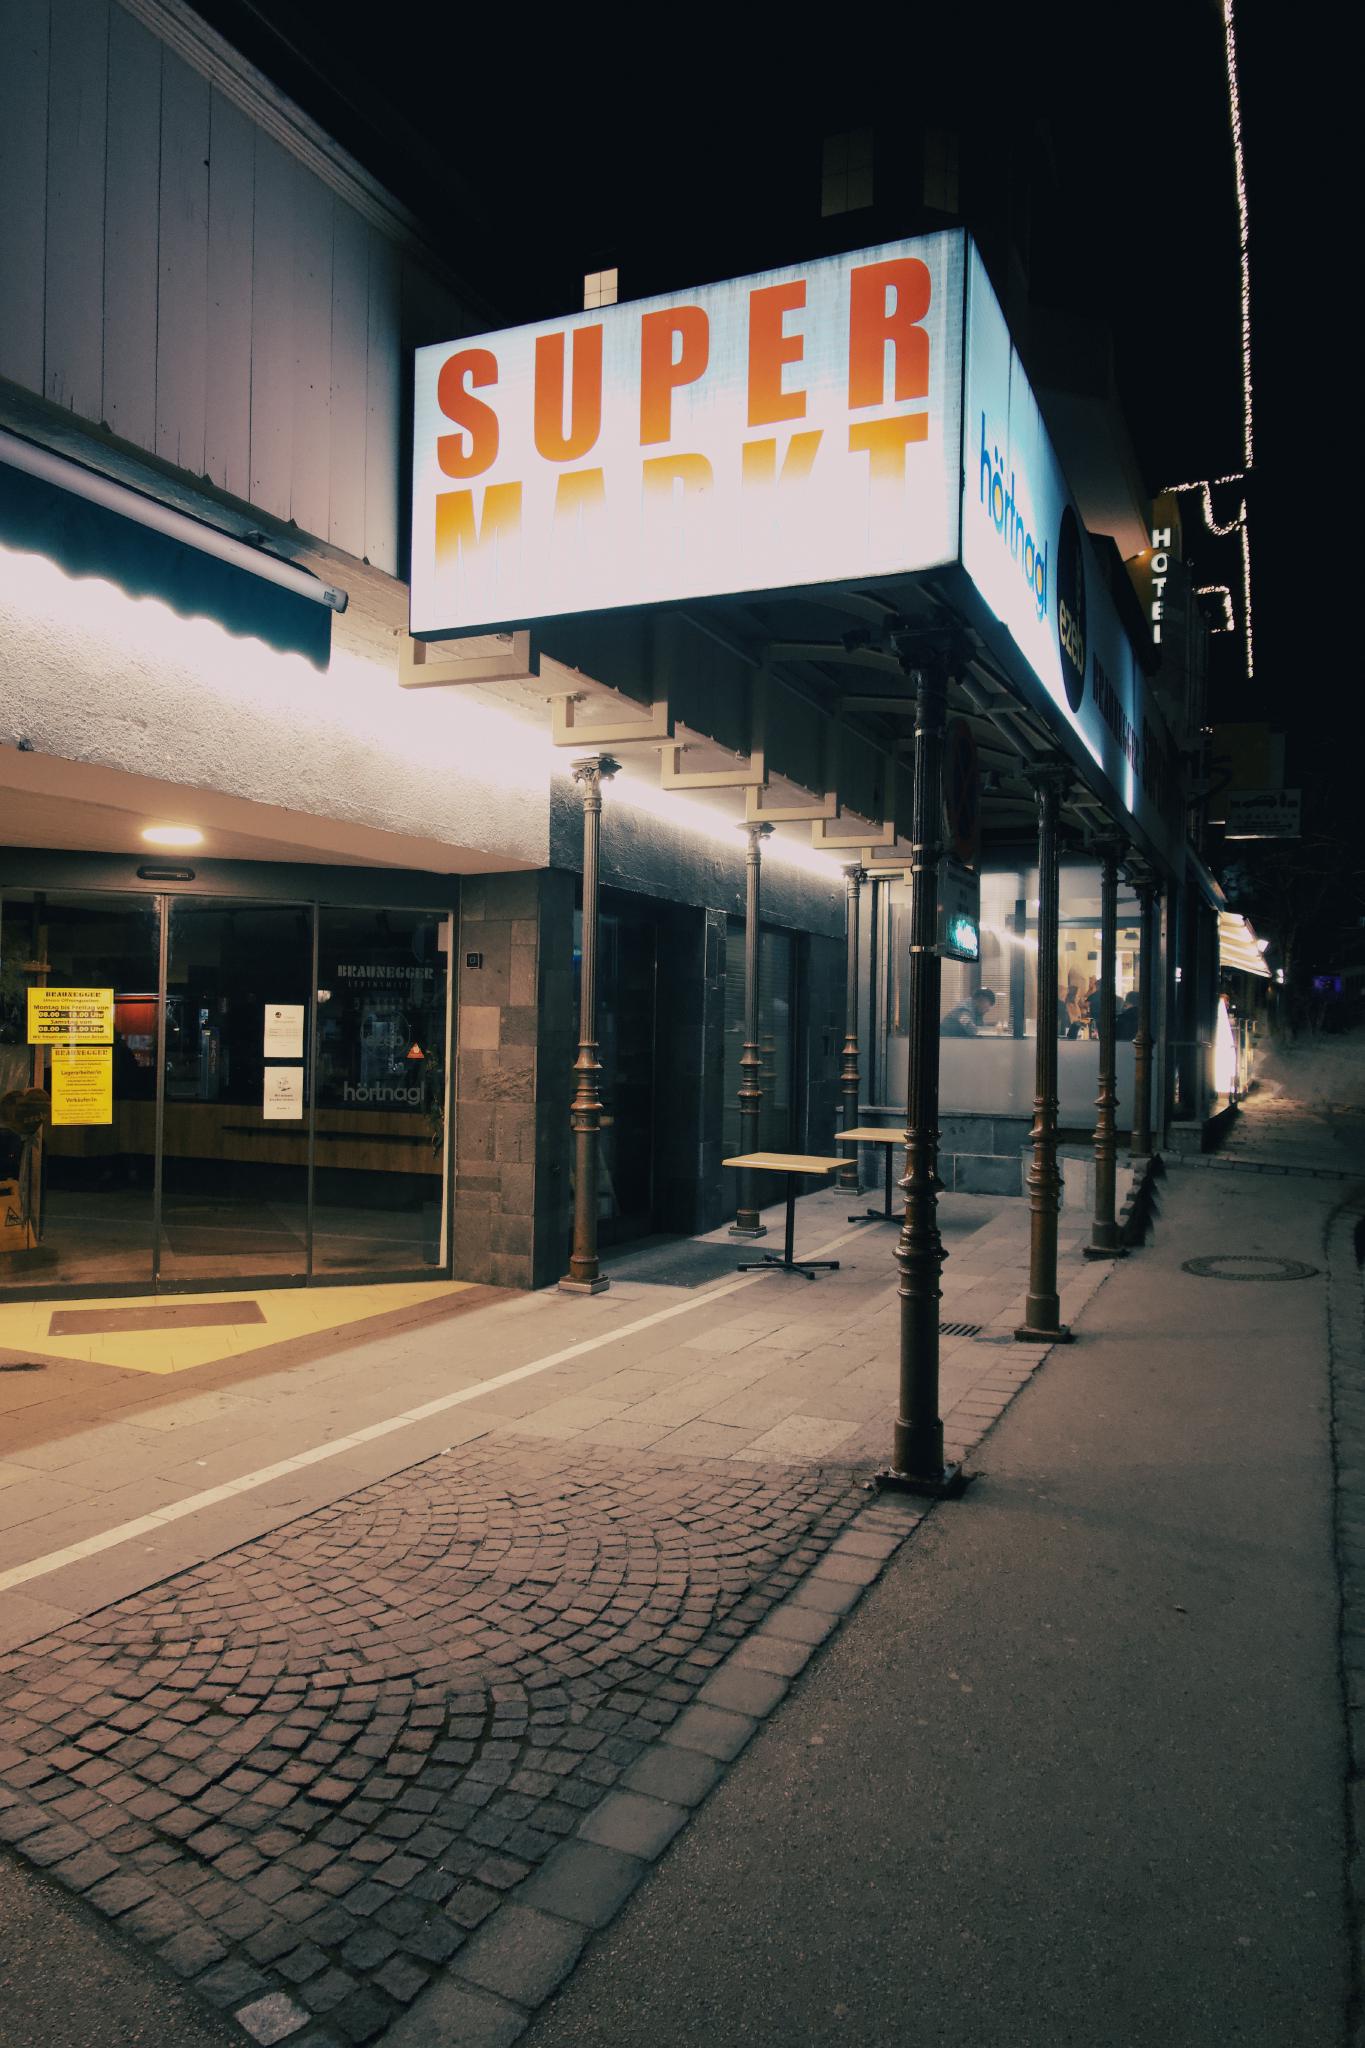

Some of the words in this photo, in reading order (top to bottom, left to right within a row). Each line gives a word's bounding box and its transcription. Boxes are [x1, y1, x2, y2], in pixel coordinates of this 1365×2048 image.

[437, 257, 931, 479] SUPER
[981, 410, 1048, 622] hörtnagl
[337, 964, 434, 979] BRAUNEGGER
[33, 1004, 60, 1012] Montag
[343, 1081, 425, 1105] hörtnagl
